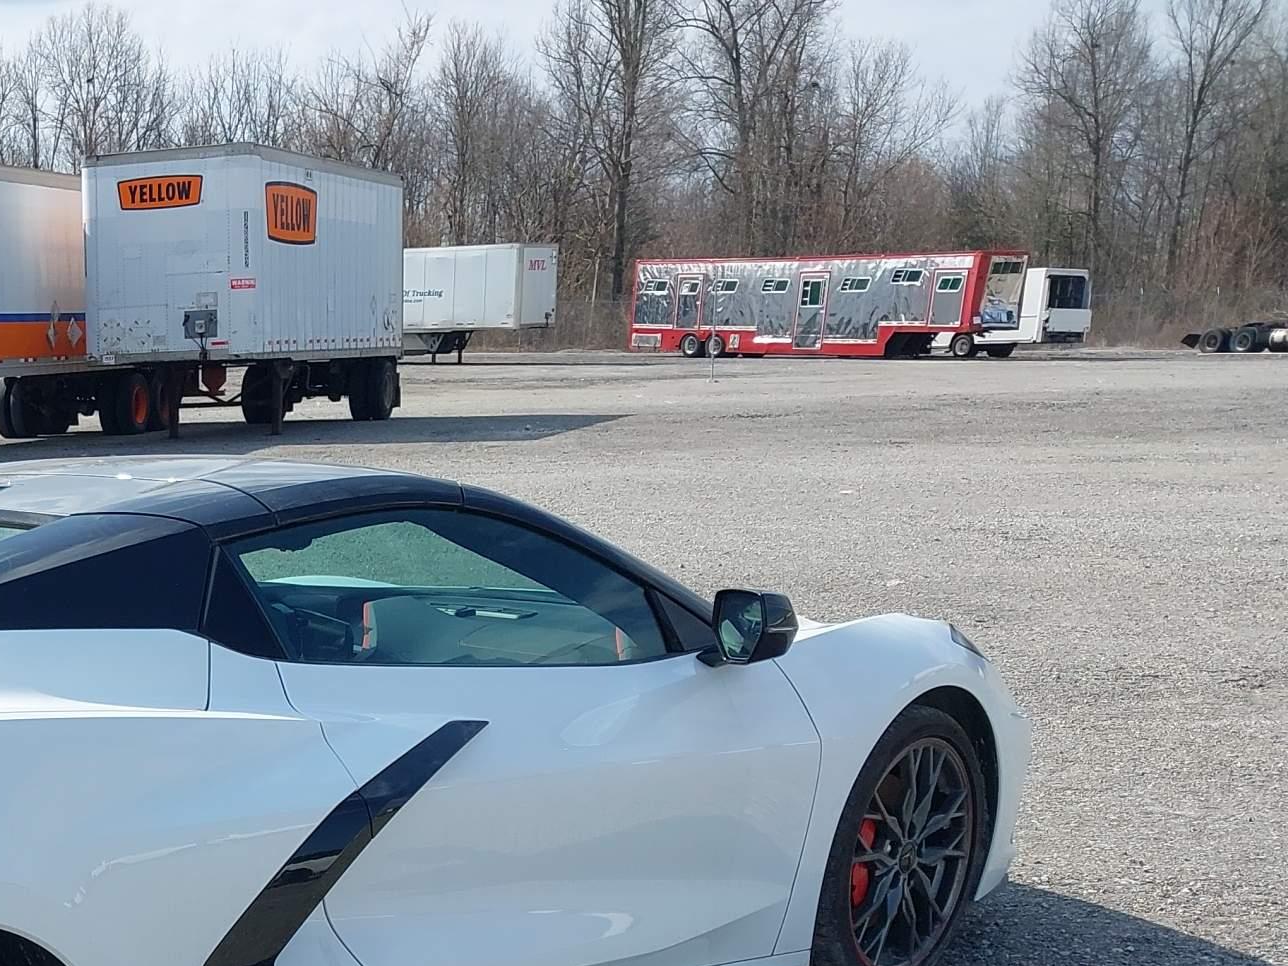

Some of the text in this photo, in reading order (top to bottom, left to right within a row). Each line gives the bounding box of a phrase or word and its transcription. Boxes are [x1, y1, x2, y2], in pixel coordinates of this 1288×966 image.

[128, 180, 193, 204] YELLOW
[272, 192, 312, 233] YELLOW
[412, 289, 444, 299] Trucking
